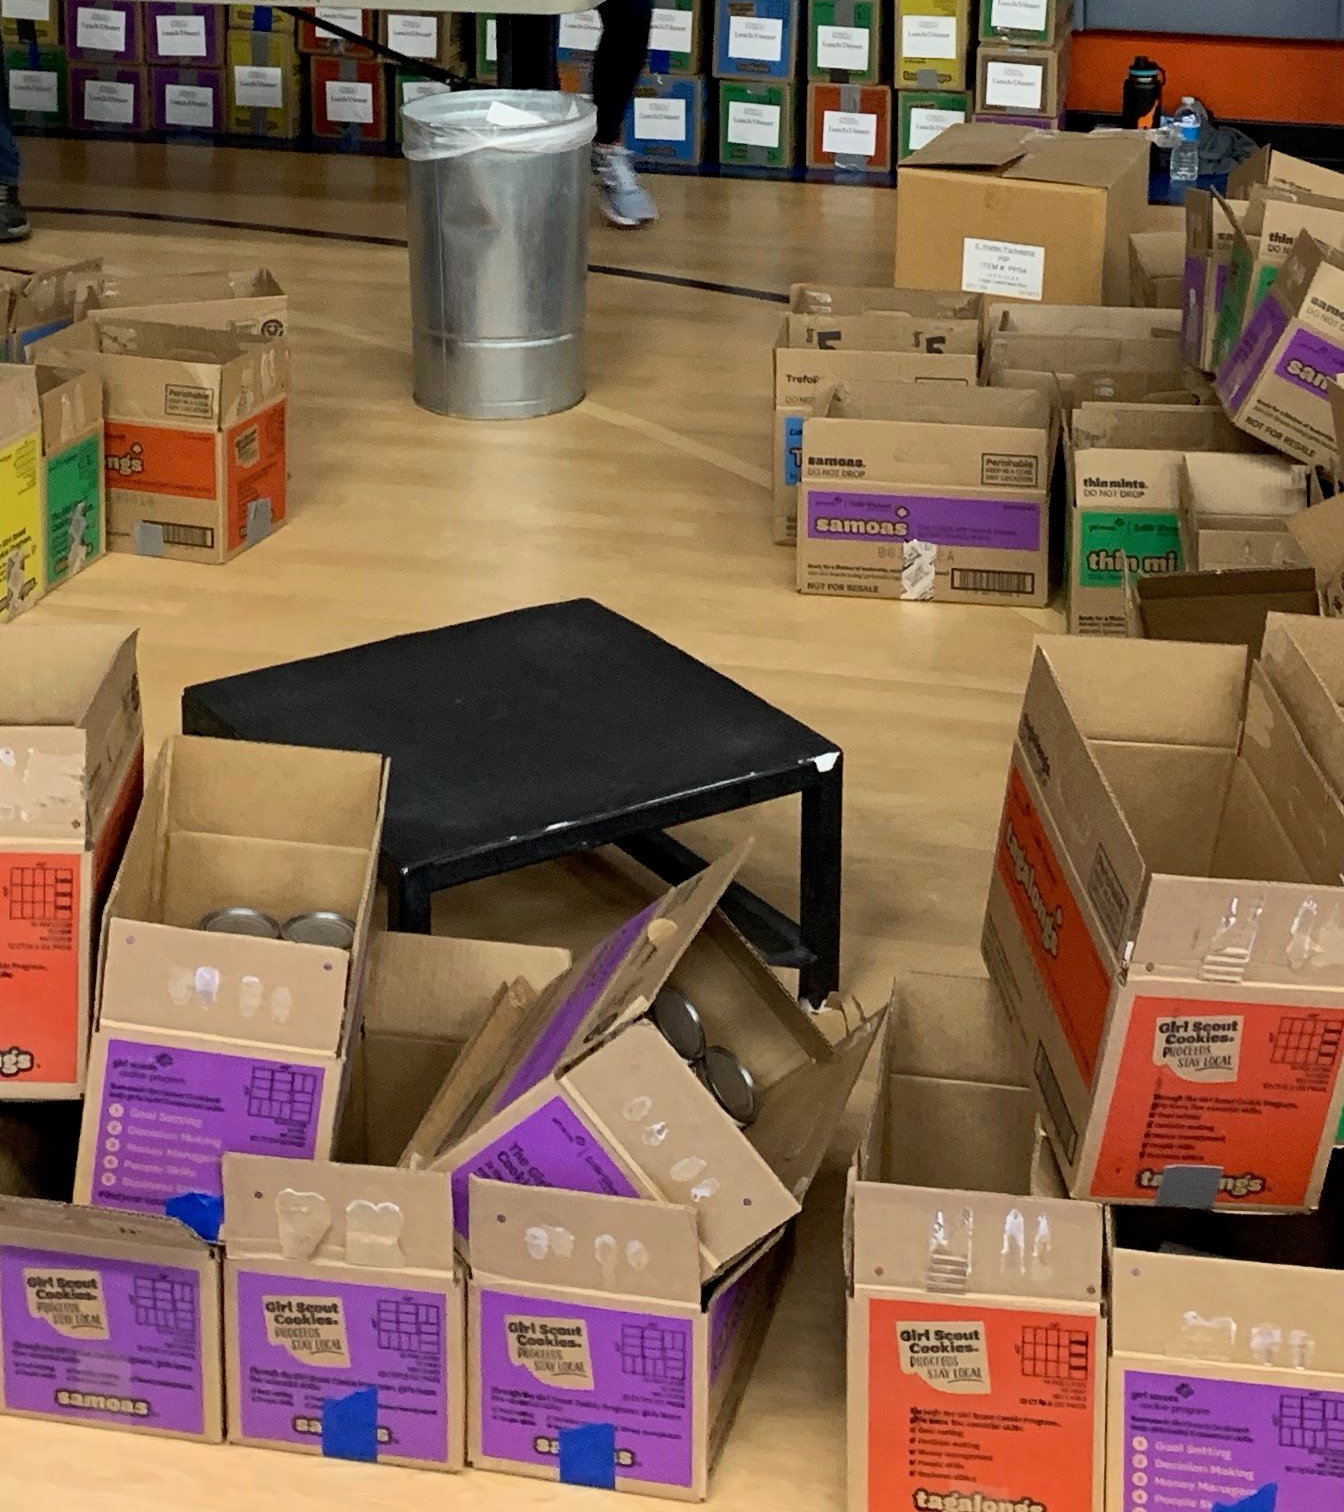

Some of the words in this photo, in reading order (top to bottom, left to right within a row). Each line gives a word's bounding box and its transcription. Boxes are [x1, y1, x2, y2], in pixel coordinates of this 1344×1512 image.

[808, 469, 824, 477] DO
[826, 470, 841, 478] NOT
[843, 470, 865, 478] DROP
[1083, 478, 1108, 487] thin
[816, 515, 908, 536] samoas
[1087, 549, 1140, 572] thin
[808, 582, 825, 591] NOT
[828, 583, 845, 591] FOR
[847, 583, 879, 593] RESALE
[1159, 1021, 1189, 1033] Girl
[1193, 1021, 1238, 1033] Scout
[266, 1301, 293, 1313] Girl
[296, 1302, 338, 1314] Scout
[509, 1322, 535, 1334] Girl
[539, 1325, 581, 1337] Scout
[900, 1330, 930, 1342] Girl
[934, 1330, 980, 1341] Scout
[54, 1389, 152, 1418] samoas
[912, 1488, 1046, 1512] tagalongs
